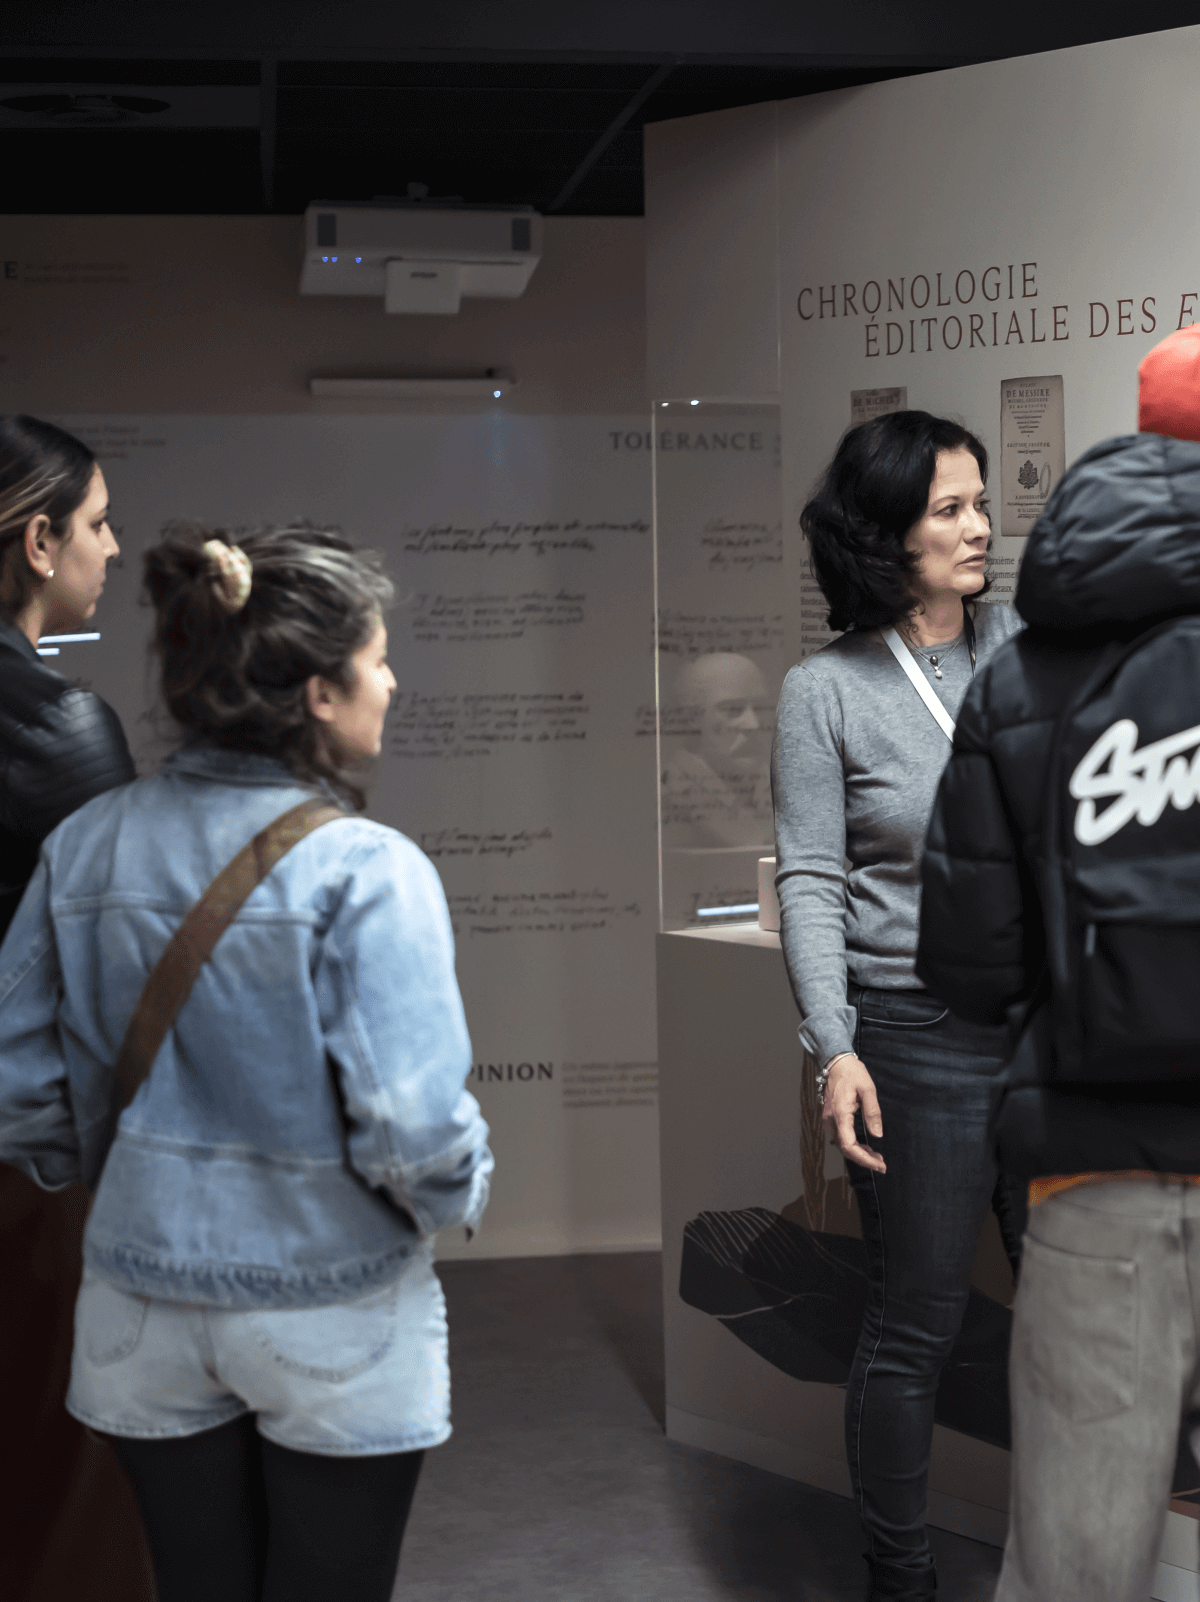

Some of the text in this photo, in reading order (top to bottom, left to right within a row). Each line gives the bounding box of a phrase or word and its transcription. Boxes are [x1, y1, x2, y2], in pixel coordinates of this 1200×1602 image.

[797, 262, 1039, 321] CHRONOLOGIE
[864, 305, 1070, 357] ÉDITORIALE
[1088, 296, 1157, 338] DES
[1019, 389, 1050, 397] MESSIRE
[609, 427, 763, 450] TOLÉRANCE
[985, 556, 1014, 565] euxième
[469, 1062, 554, 1082] INION
